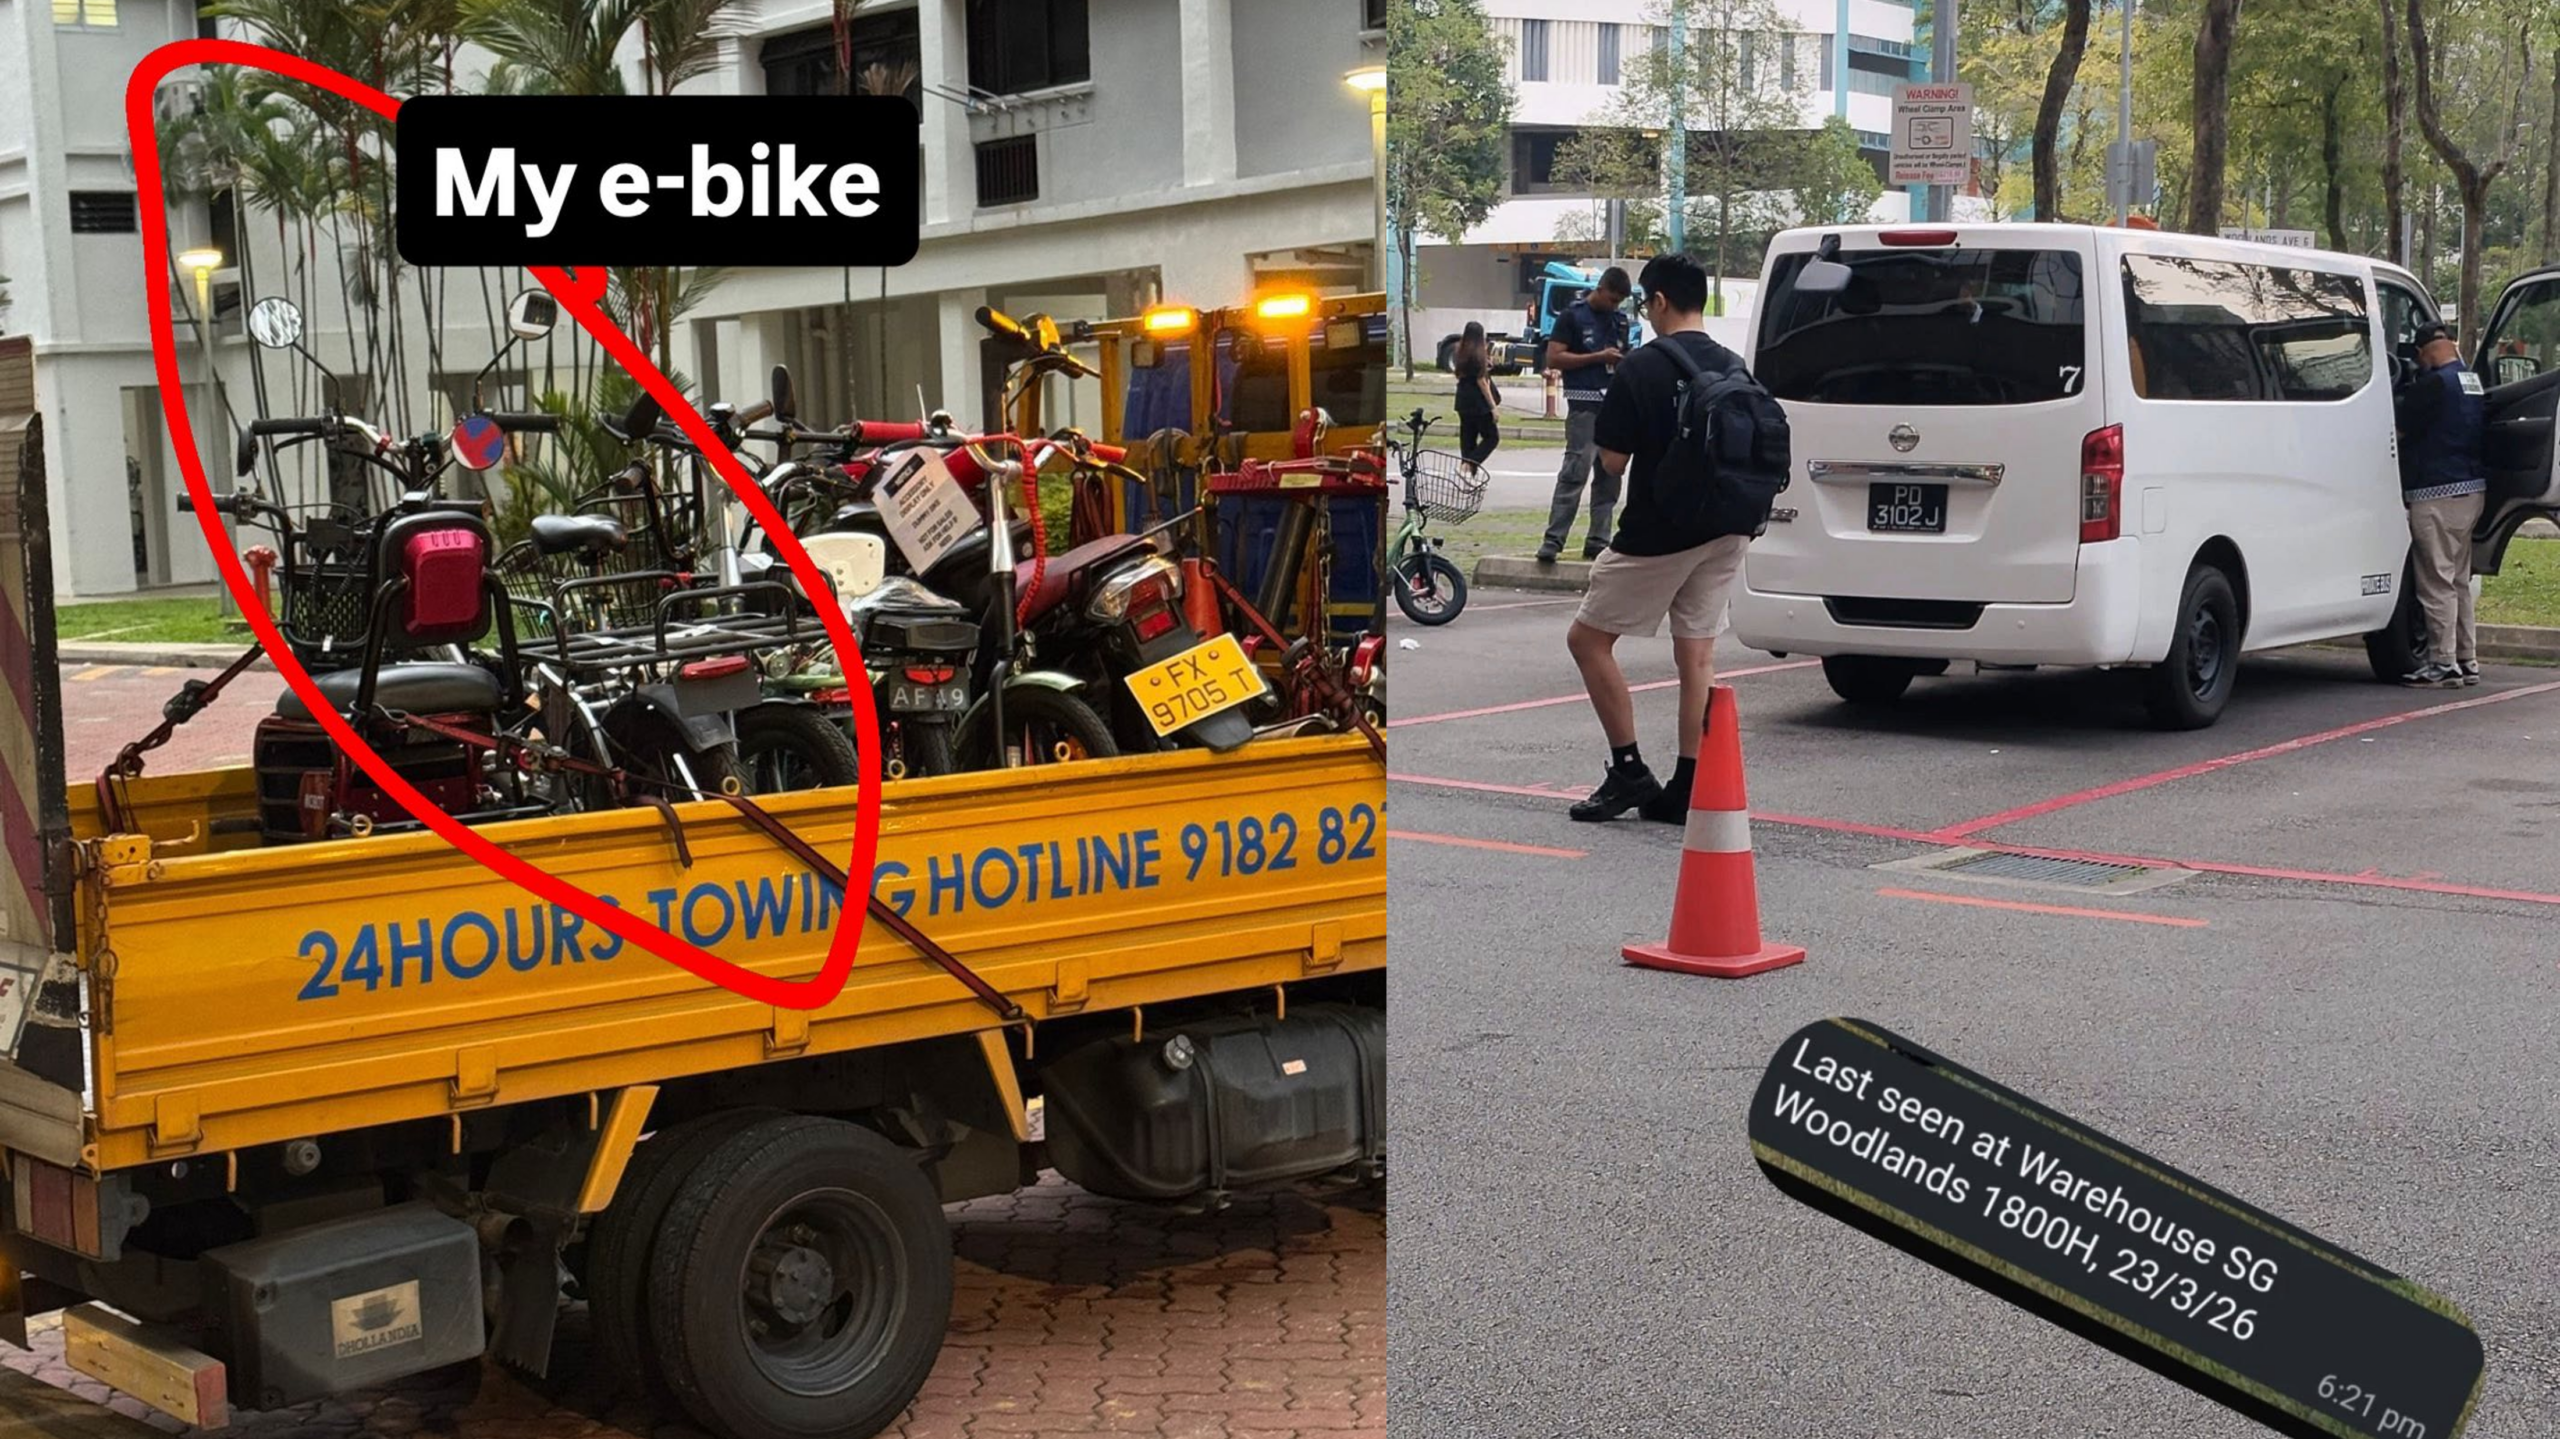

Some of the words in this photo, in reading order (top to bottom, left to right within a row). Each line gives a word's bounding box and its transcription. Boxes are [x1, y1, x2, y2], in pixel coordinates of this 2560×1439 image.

[1906, 88, 1959, 100] WARNING!
[1898, 105, 1921, 114] Wheel
[1922, 105, 1946, 114] Clamp
[1947, 104, 1966, 113] Area
[2281, 236, 2300, 247] AVE
[2058, 365, 2082, 393] 7
[1895, 485, 1922, 506] PD
[1165, 654, 1208, 688] FX
[1151, 679, 1228, 728] 9705
[1228, 667, 1251, 693] T
[297, 894, 624, 1001] 24HOURS
[929, 829, 1161, 917] HOTLINE
[1179, 811, 1298, 882] 9182
[1316, 801, 1387, 866] 82
[337, 1323, 421, 1354] DHOLLANDIA
